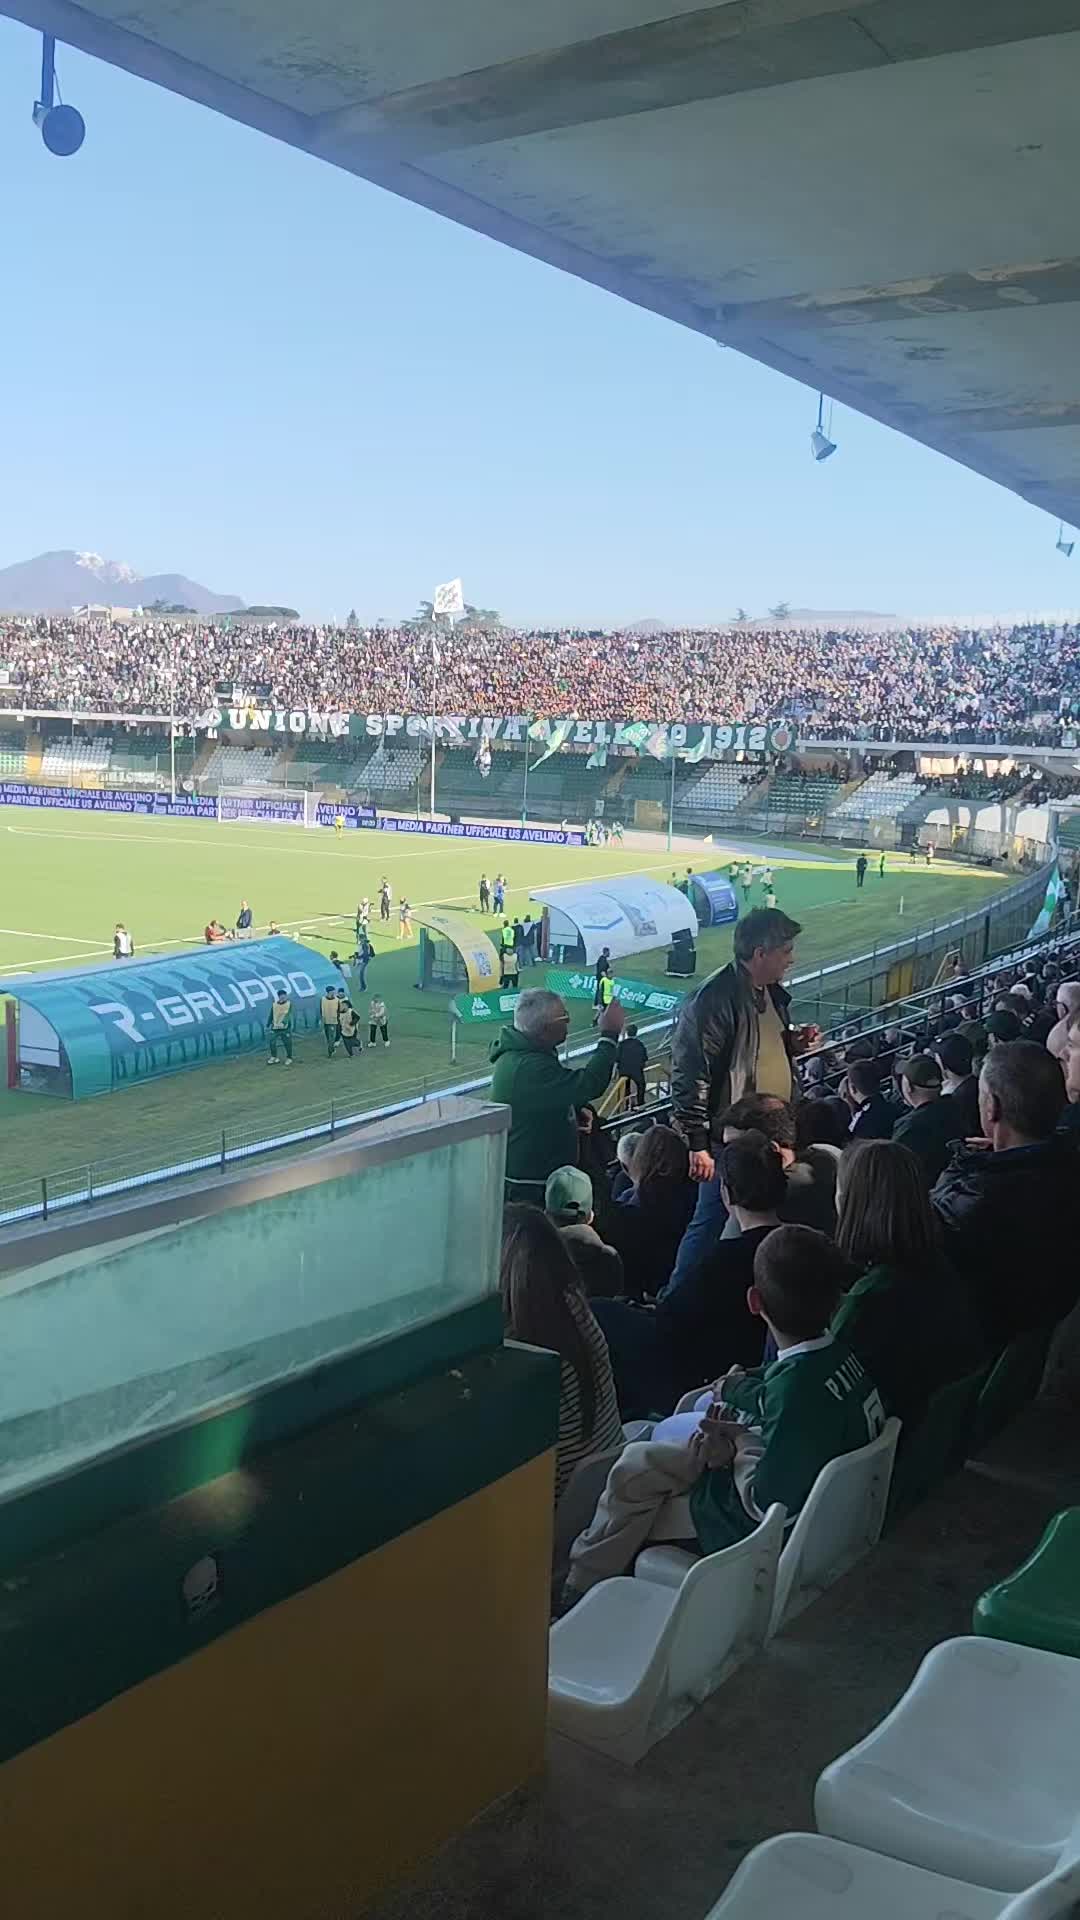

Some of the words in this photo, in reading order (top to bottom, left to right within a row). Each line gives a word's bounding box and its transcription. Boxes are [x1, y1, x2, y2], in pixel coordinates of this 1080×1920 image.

[227, 708, 350, 736] UNIONE
[530, 719, 687, 747] VELLO
[702, 725, 767, 751] 1912
[3, 784, 26, 794] MEDIA
[28, 786, 61, 797] PARTNER
[102, 791, 113, 800] US
[114, 792, 152, 802] AVELLINO
[7, 794, 41, 805] PARTNER
[42, 797, 80, 808] UFFICIALE
[81, 799, 92, 809] US
[94, 800, 131, 811] AVELLINO
[167, 804, 194, 815] MEDIA
[397, 820, 423, 832] MEDIA
[425, 822, 464, 835] PARTNER
[466, 825, 507, 838] UFFICIALE
[509, 828, 520, 839] US
[522, 829, 565, 842] AVELLINO
[89, 971, 317, 1043] R-GRUPPO
